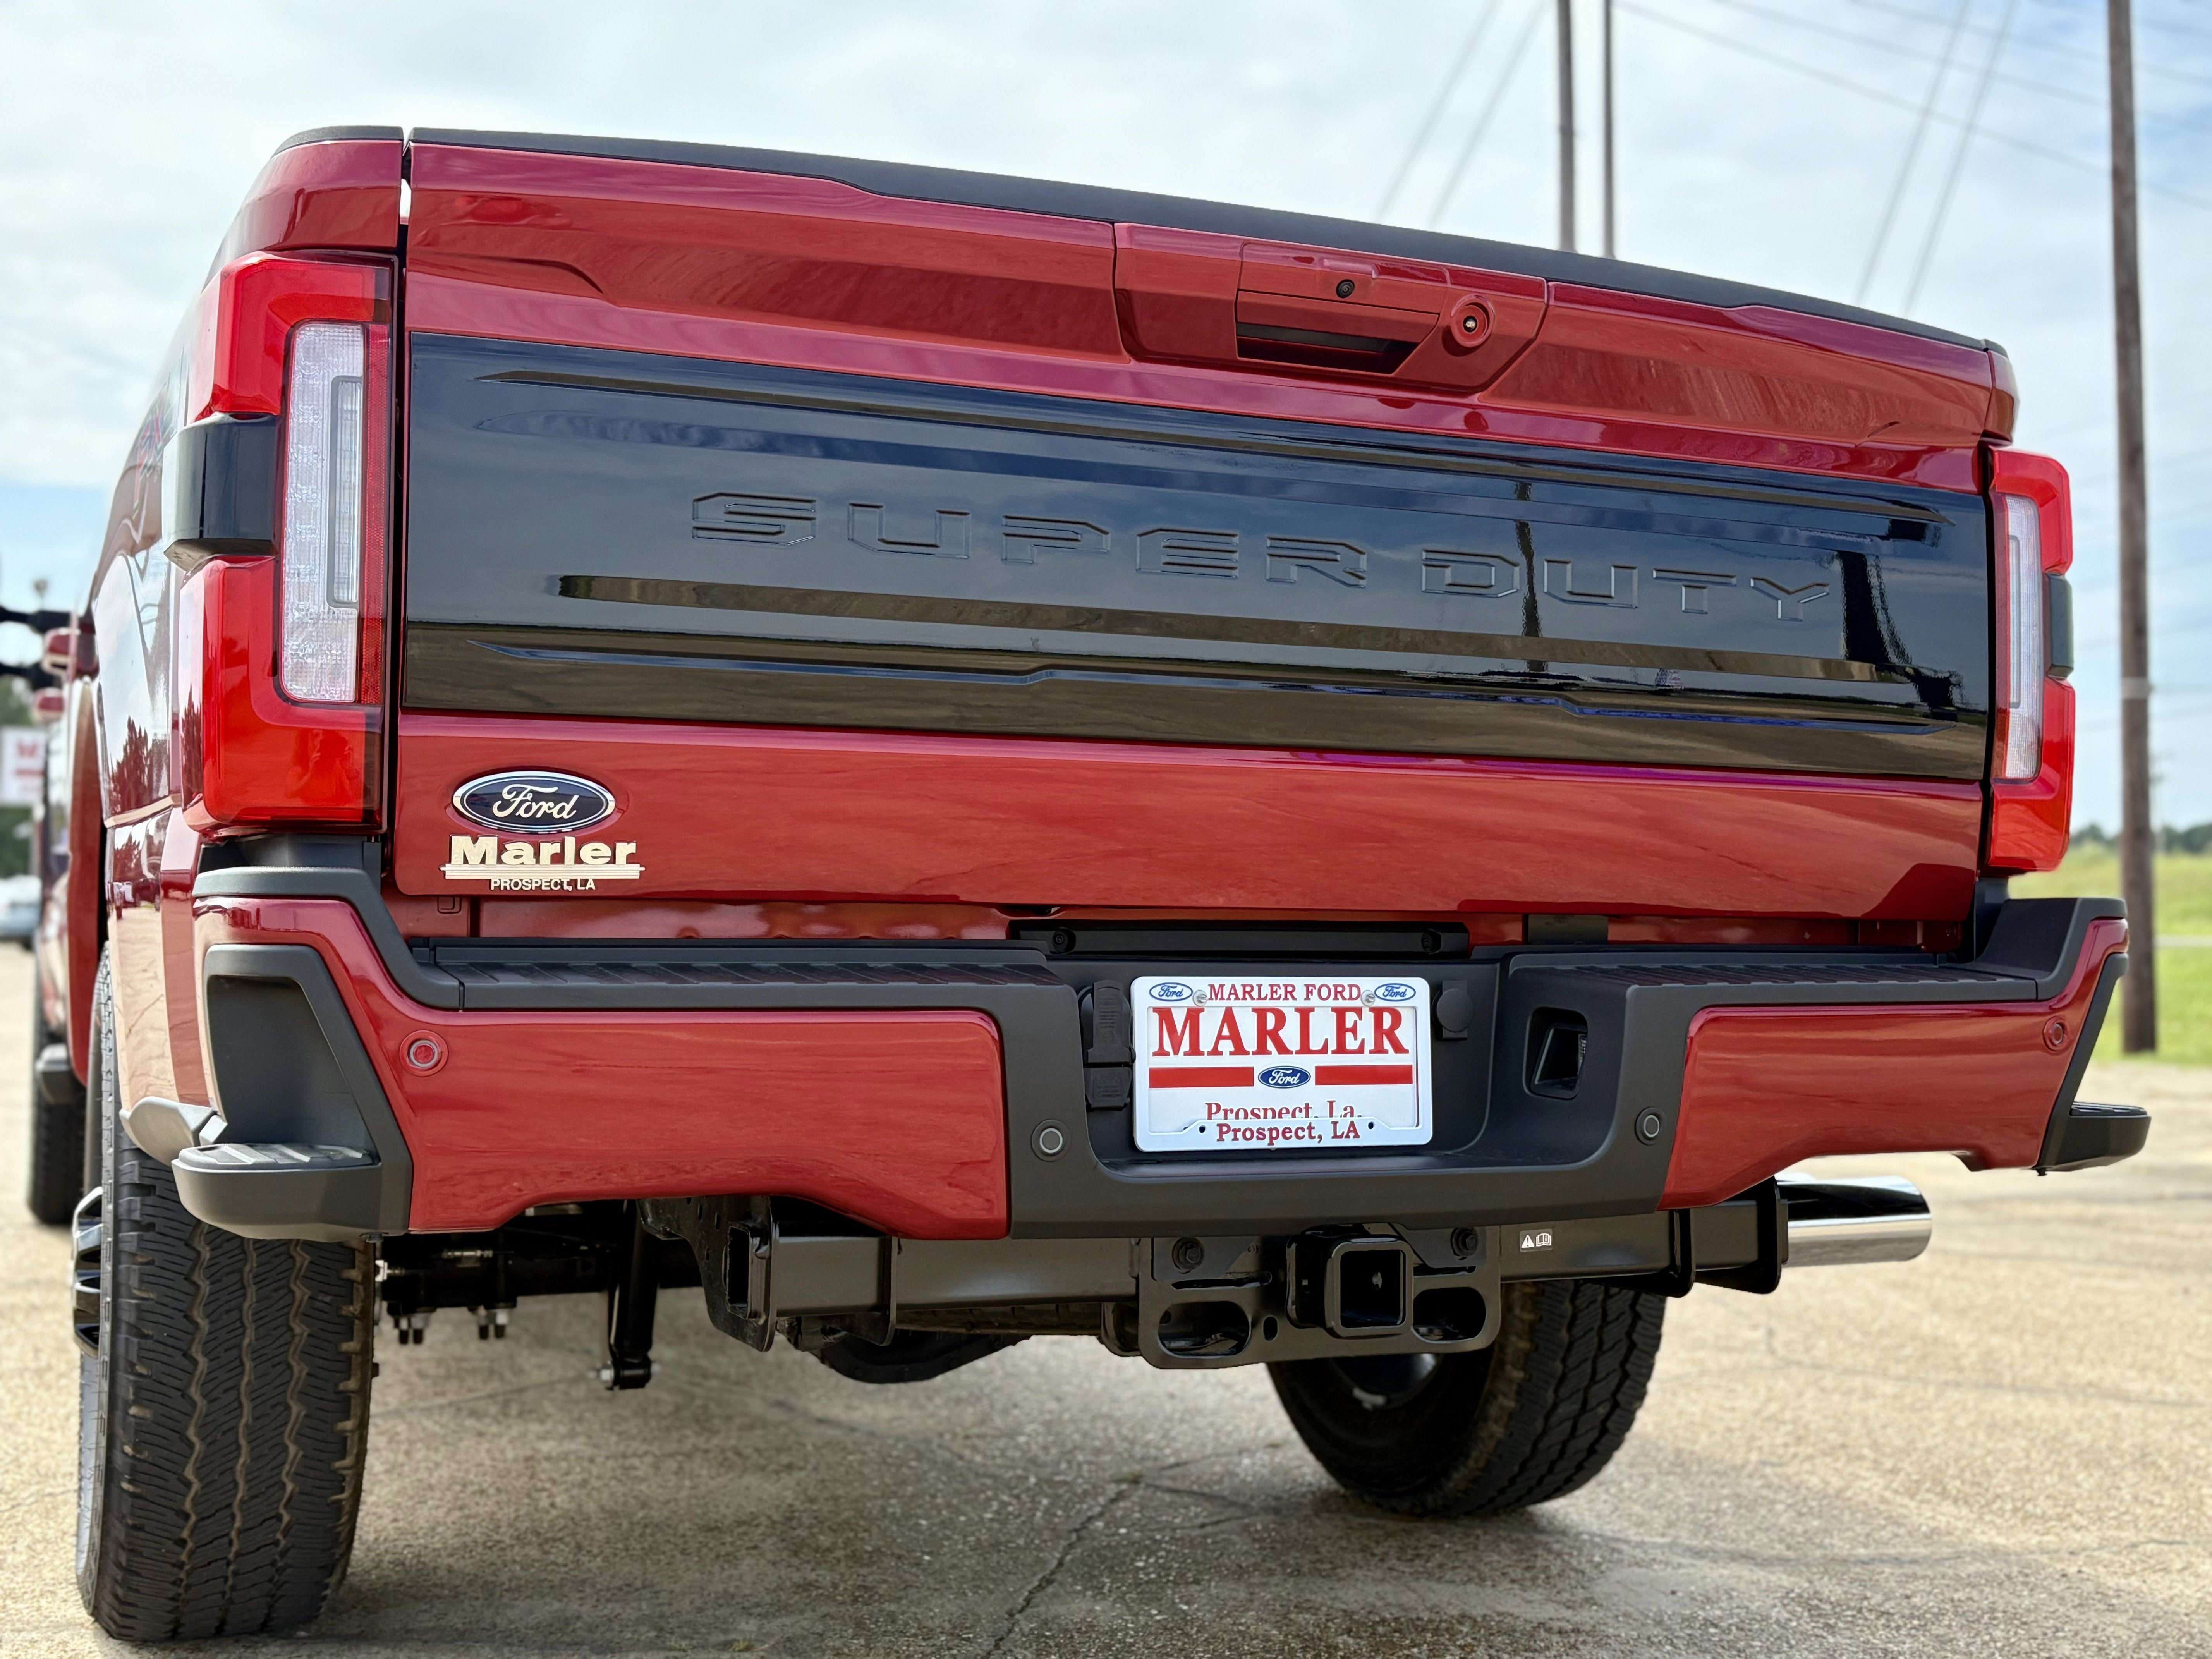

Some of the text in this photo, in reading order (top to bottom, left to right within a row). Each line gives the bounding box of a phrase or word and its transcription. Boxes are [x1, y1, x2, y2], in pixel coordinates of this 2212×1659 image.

[692, 492, 1830, 621] SUPER DUTY
[492, 783, 579, 819] Ford
[450, 834, 637, 865] Marler
[491, 879, 596, 891] PROSPECT, LA
[1158, 985, 1184, 998] Ford
[1208, 984, 1361, 1001] MARLER FORD
[1382, 986, 1407, 998] Ford
[1152, 1007, 1409, 1057] MARLER
[1269, 1070, 1300, 1084] Ford
[1216, 1120, 1360, 1146] Prospect, LA
